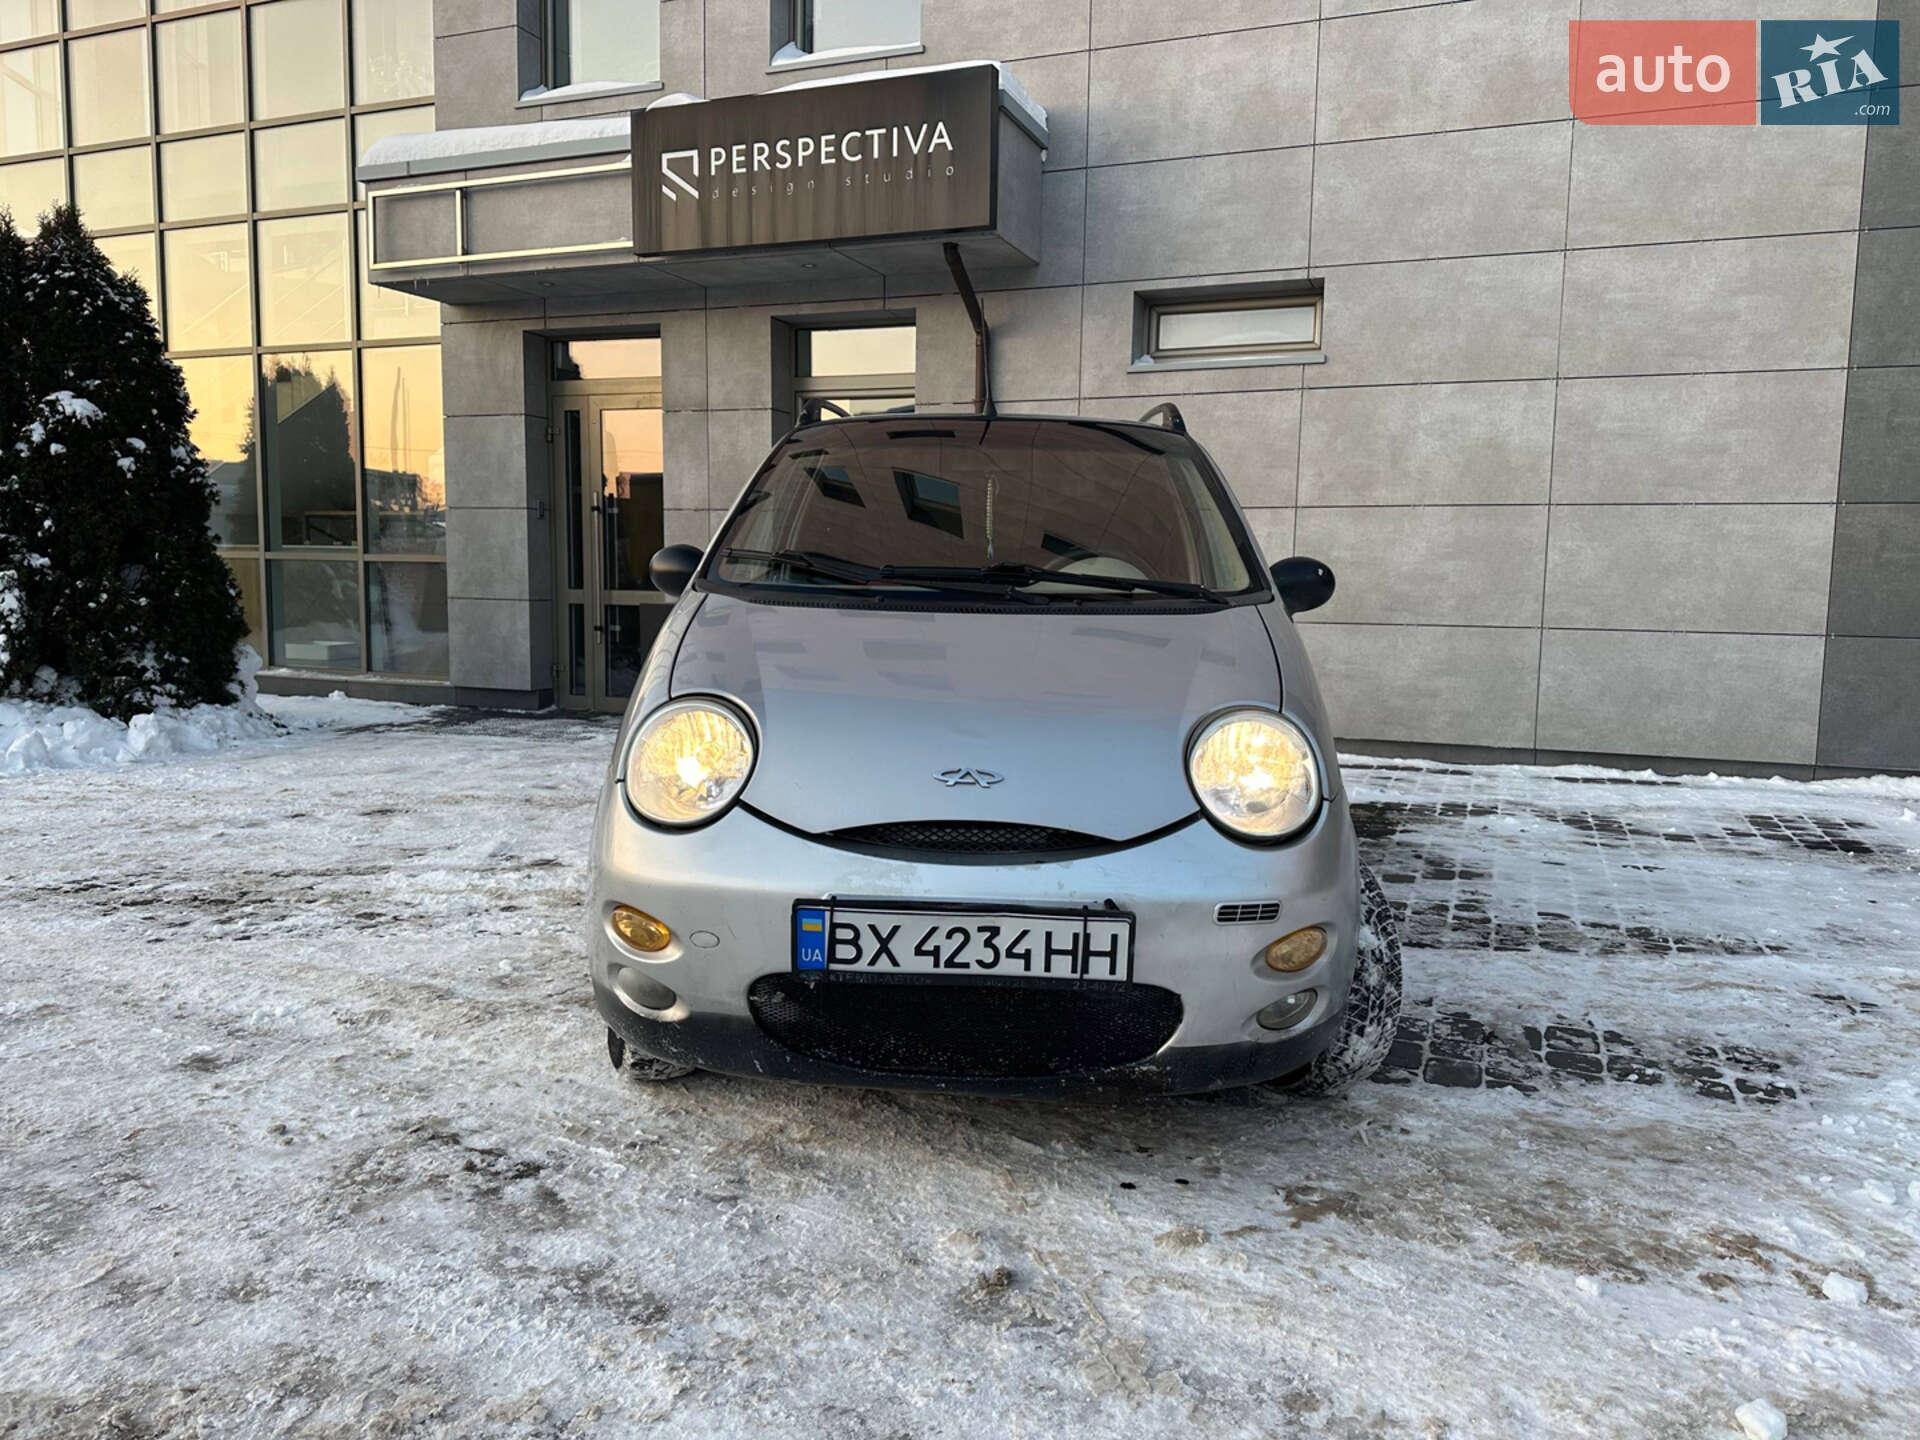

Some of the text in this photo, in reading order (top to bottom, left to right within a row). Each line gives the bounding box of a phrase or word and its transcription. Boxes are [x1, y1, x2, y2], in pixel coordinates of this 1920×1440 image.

[710, 121, 954, 176] PERSPECTIVA
[712, 166, 955, 199] design studio
[801, 948, 823, 962] UA
[830, 922, 1118, 976] BX 4234 HH
